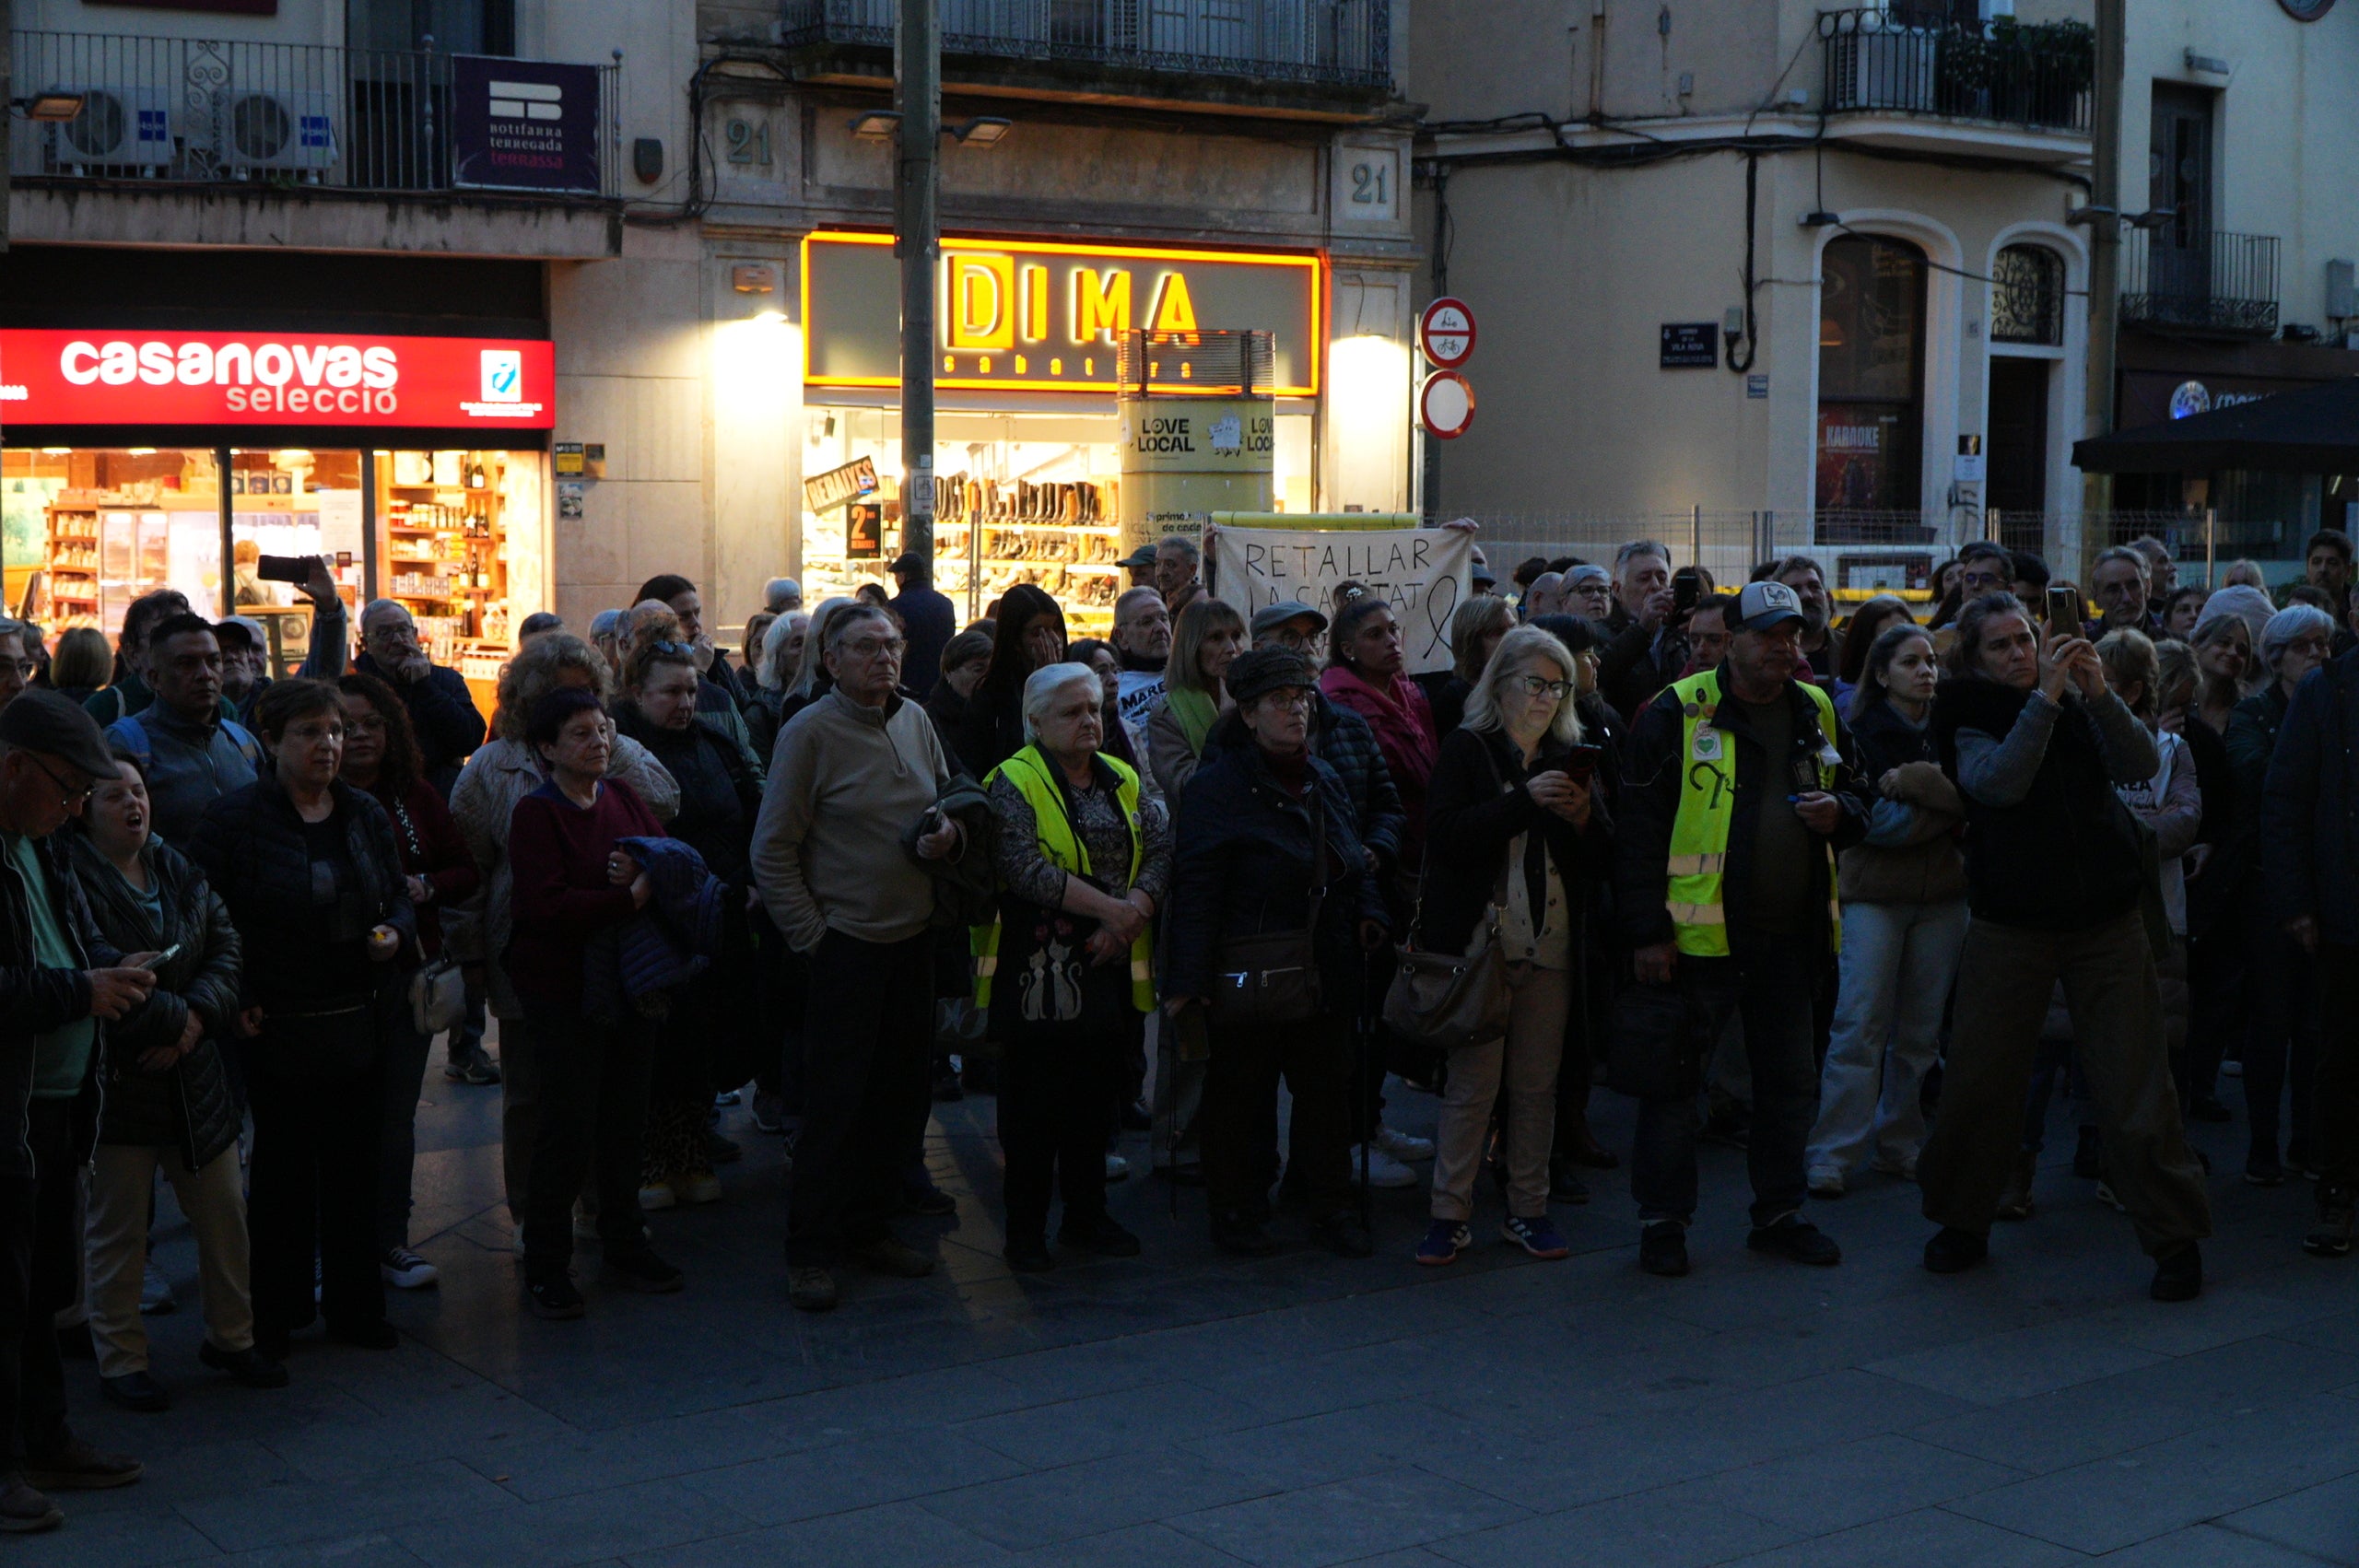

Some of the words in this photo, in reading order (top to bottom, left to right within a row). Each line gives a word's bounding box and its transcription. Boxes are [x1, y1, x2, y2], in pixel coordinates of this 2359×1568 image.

[726, 117, 772, 165] 21
[1353, 162, 1387, 204] 21
[945, 253, 1201, 350] DIMA
[60, 341, 398, 389] casanovas
[226, 380, 398, 415] selecció
[1138, 436, 1195, 452] LOCAL
[1143, 418, 1190, 435] LOVE
[1826, 425, 1880, 449] KARAOKE
[806, 459, 876, 509] REBAIXES
[1246, 538, 1430, 578] RETALLAR
